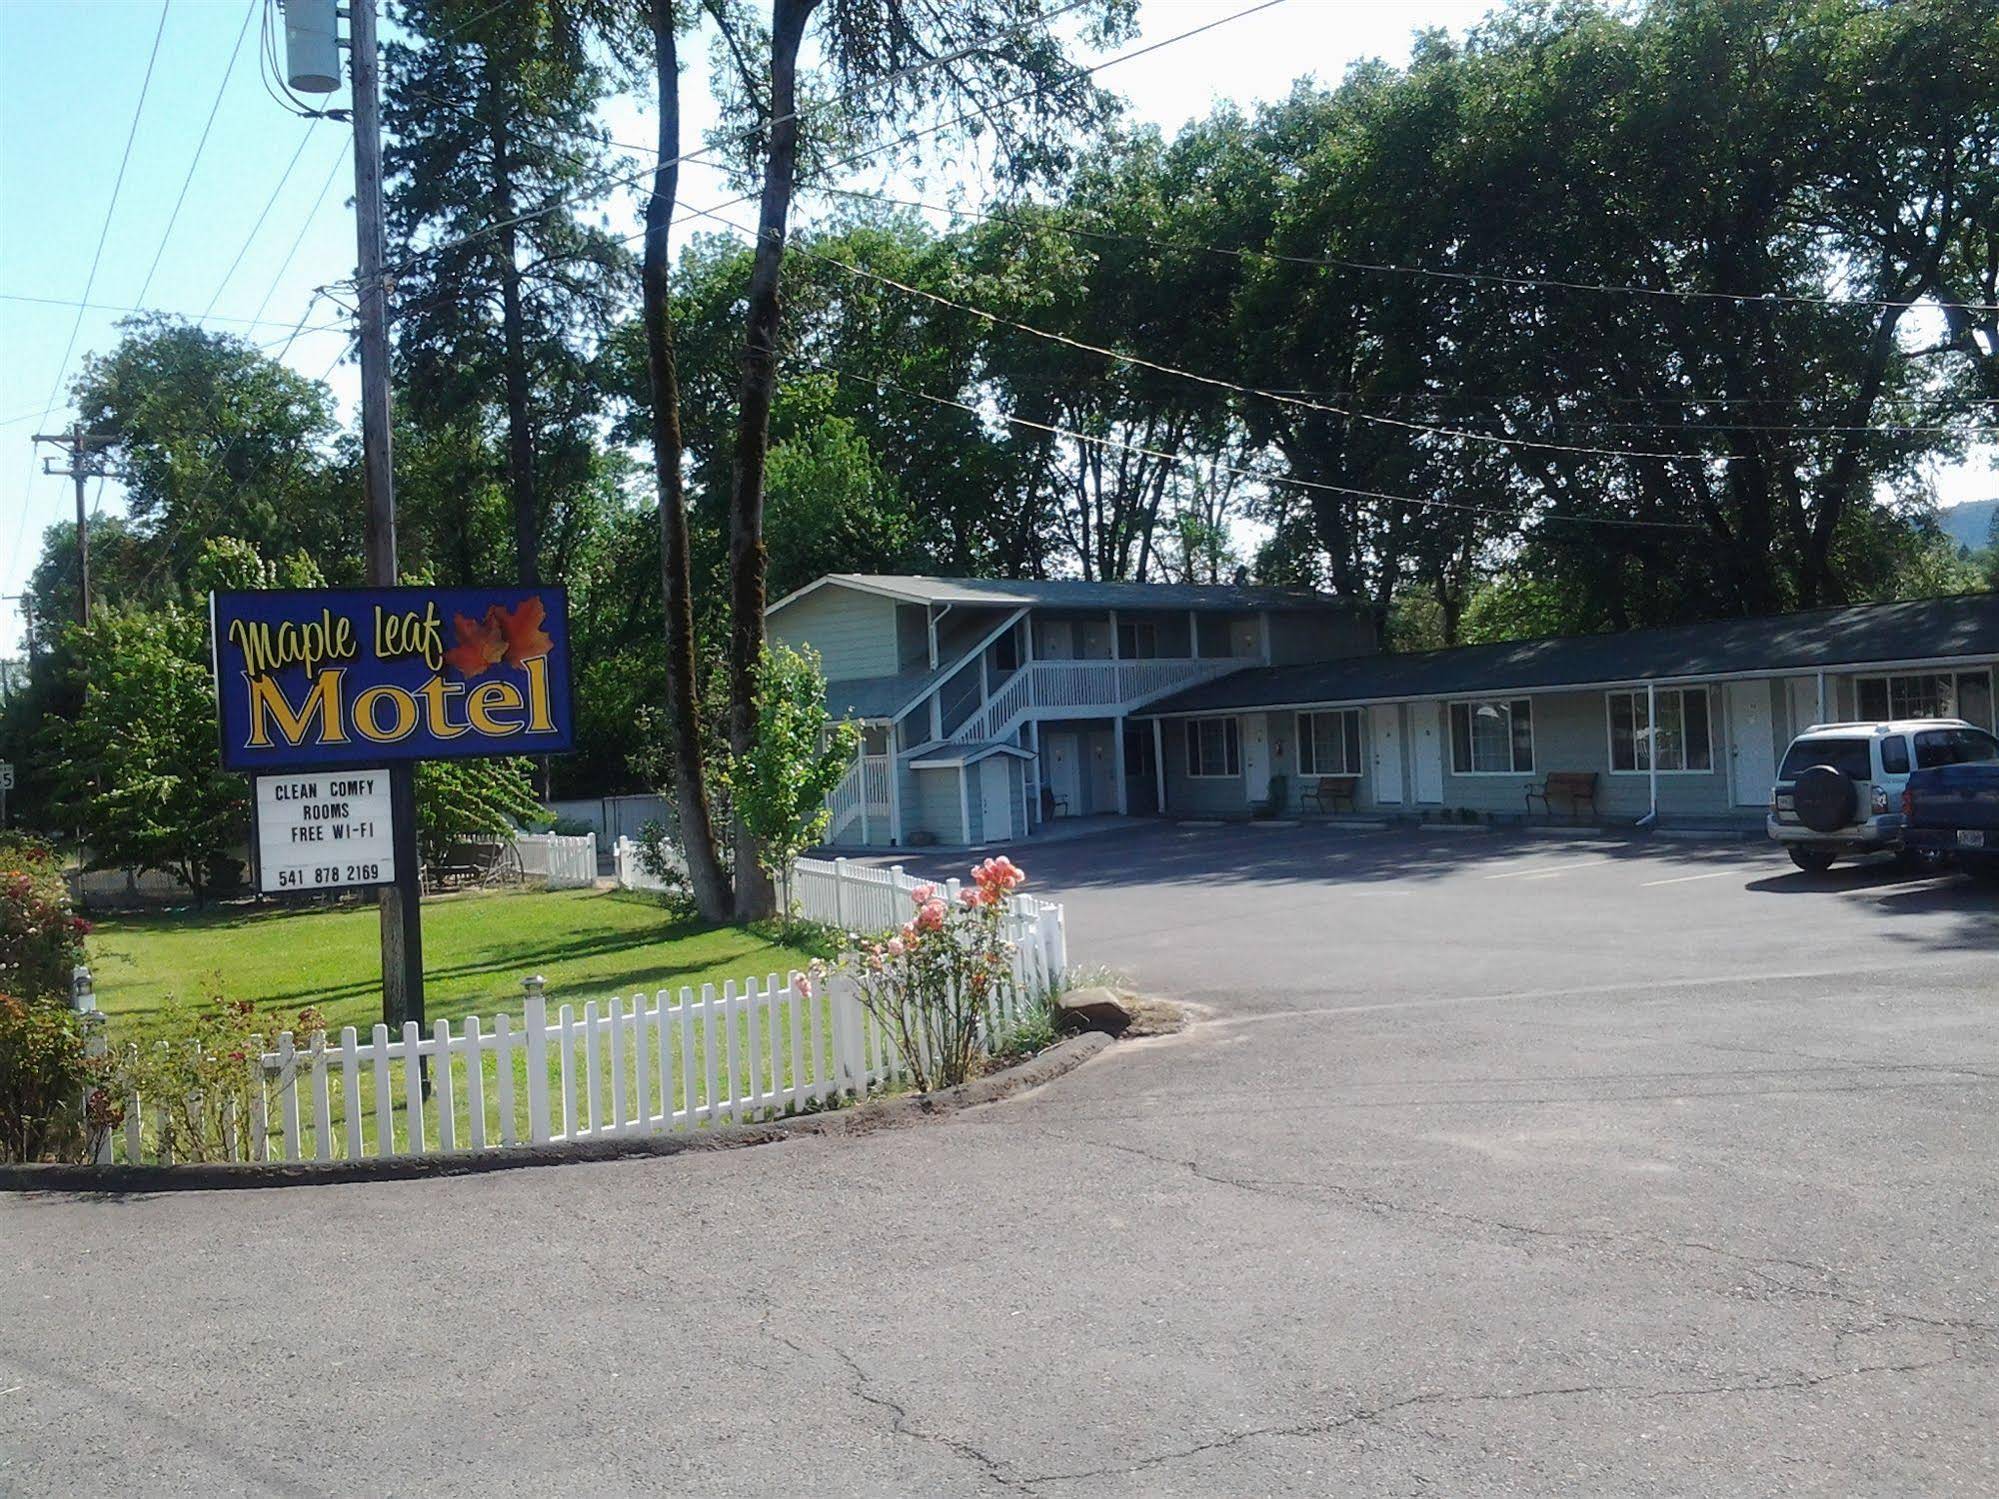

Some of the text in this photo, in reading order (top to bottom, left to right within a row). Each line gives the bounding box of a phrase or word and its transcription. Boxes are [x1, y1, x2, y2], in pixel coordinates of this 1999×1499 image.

[229, 601, 444, 679] Maple Leaf
[243, 654, 558, 748] Motel
[275, 780, 375, 801] CLEAN COMFY
[303, 803, 350, 820] ROOMS
[291, 822, 374, 842] FREE WI-FI
[279, 864, 379, 886] 541 878 2169
